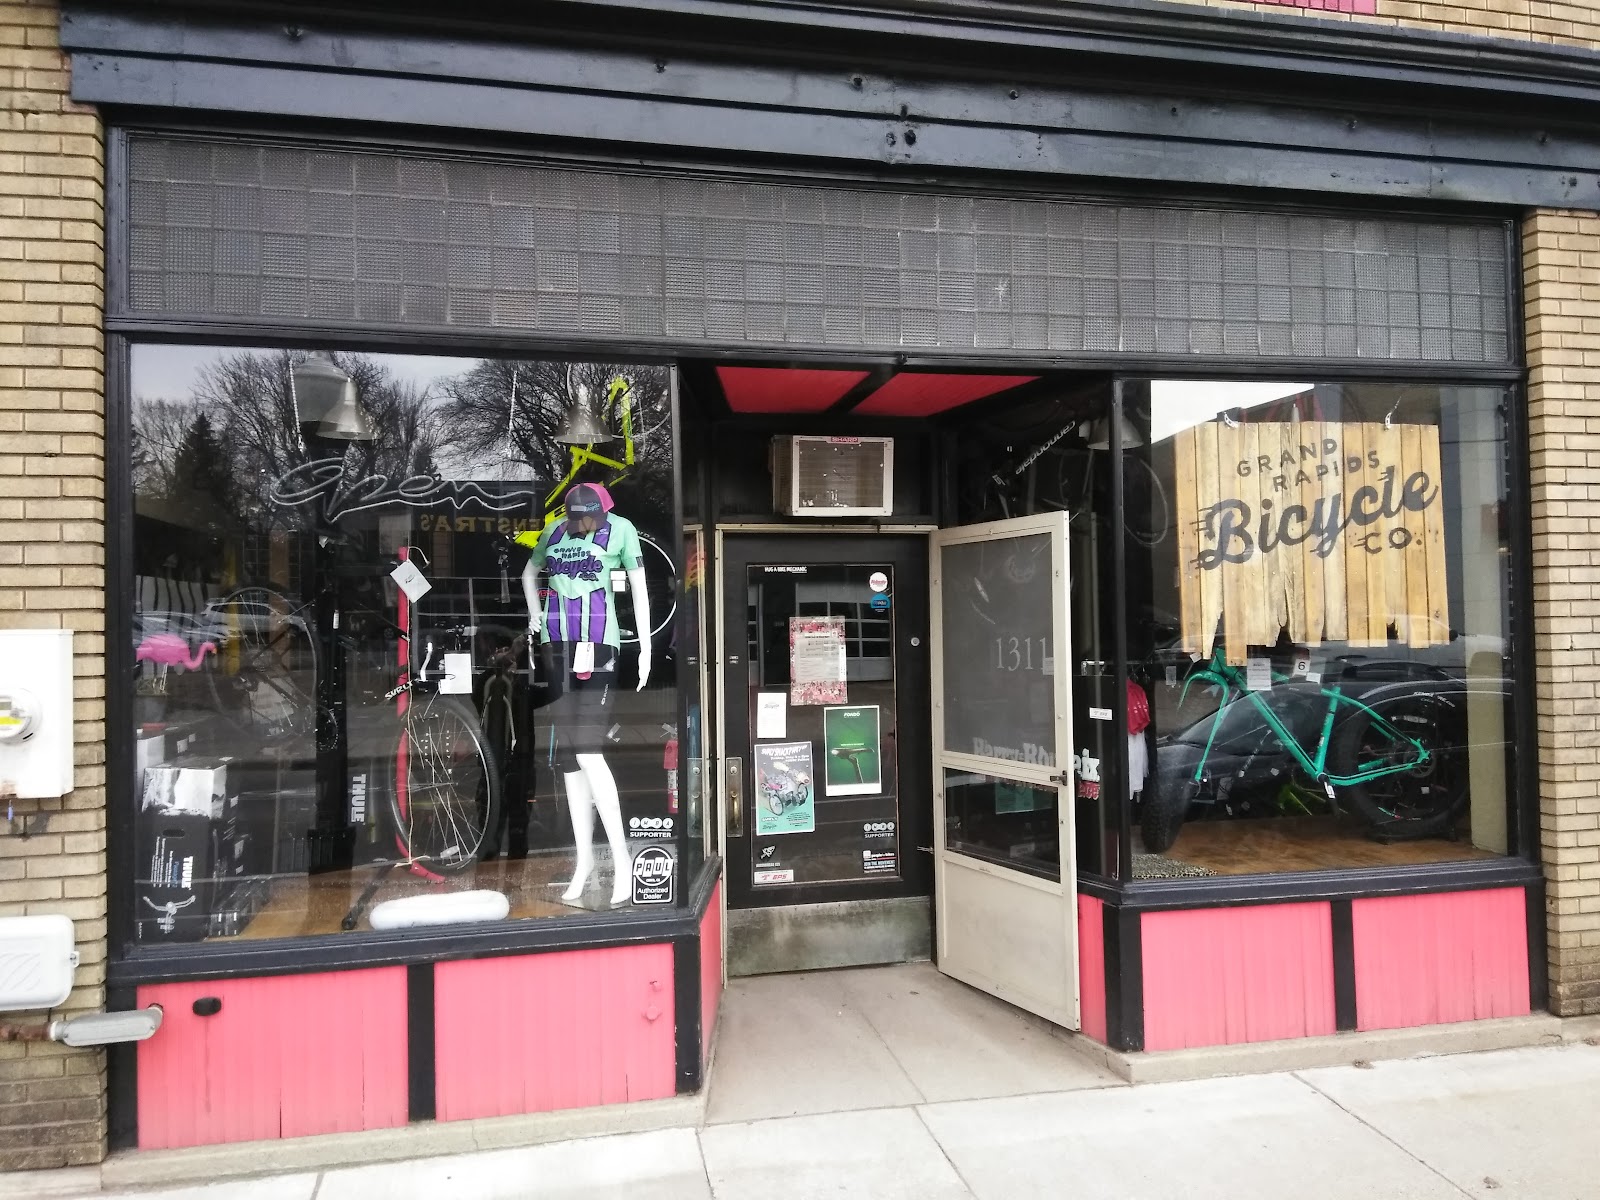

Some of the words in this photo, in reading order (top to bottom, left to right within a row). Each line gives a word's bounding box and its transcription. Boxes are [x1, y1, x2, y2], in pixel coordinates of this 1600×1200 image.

[1016, 421, 1075, 474] cannondale
[1236, 438, 1338, 478] GRAND
[1273, 450, 1380, 492] RAPIDS
[1194, 465, 1439, 570] Bicycle
[1360, 526, 1422, 554] CO.
[546, 555, 603, 580] Bicycle
[996, 636, 1048, 671] 1311
[1297, 661, 1306, 671] 6
[351, 774, 366, 823] THULE
[629, 817, 673, 828] IMBA
[182, 856, 193, 888] THULE
[635, 860, 671, 873] PAUL
